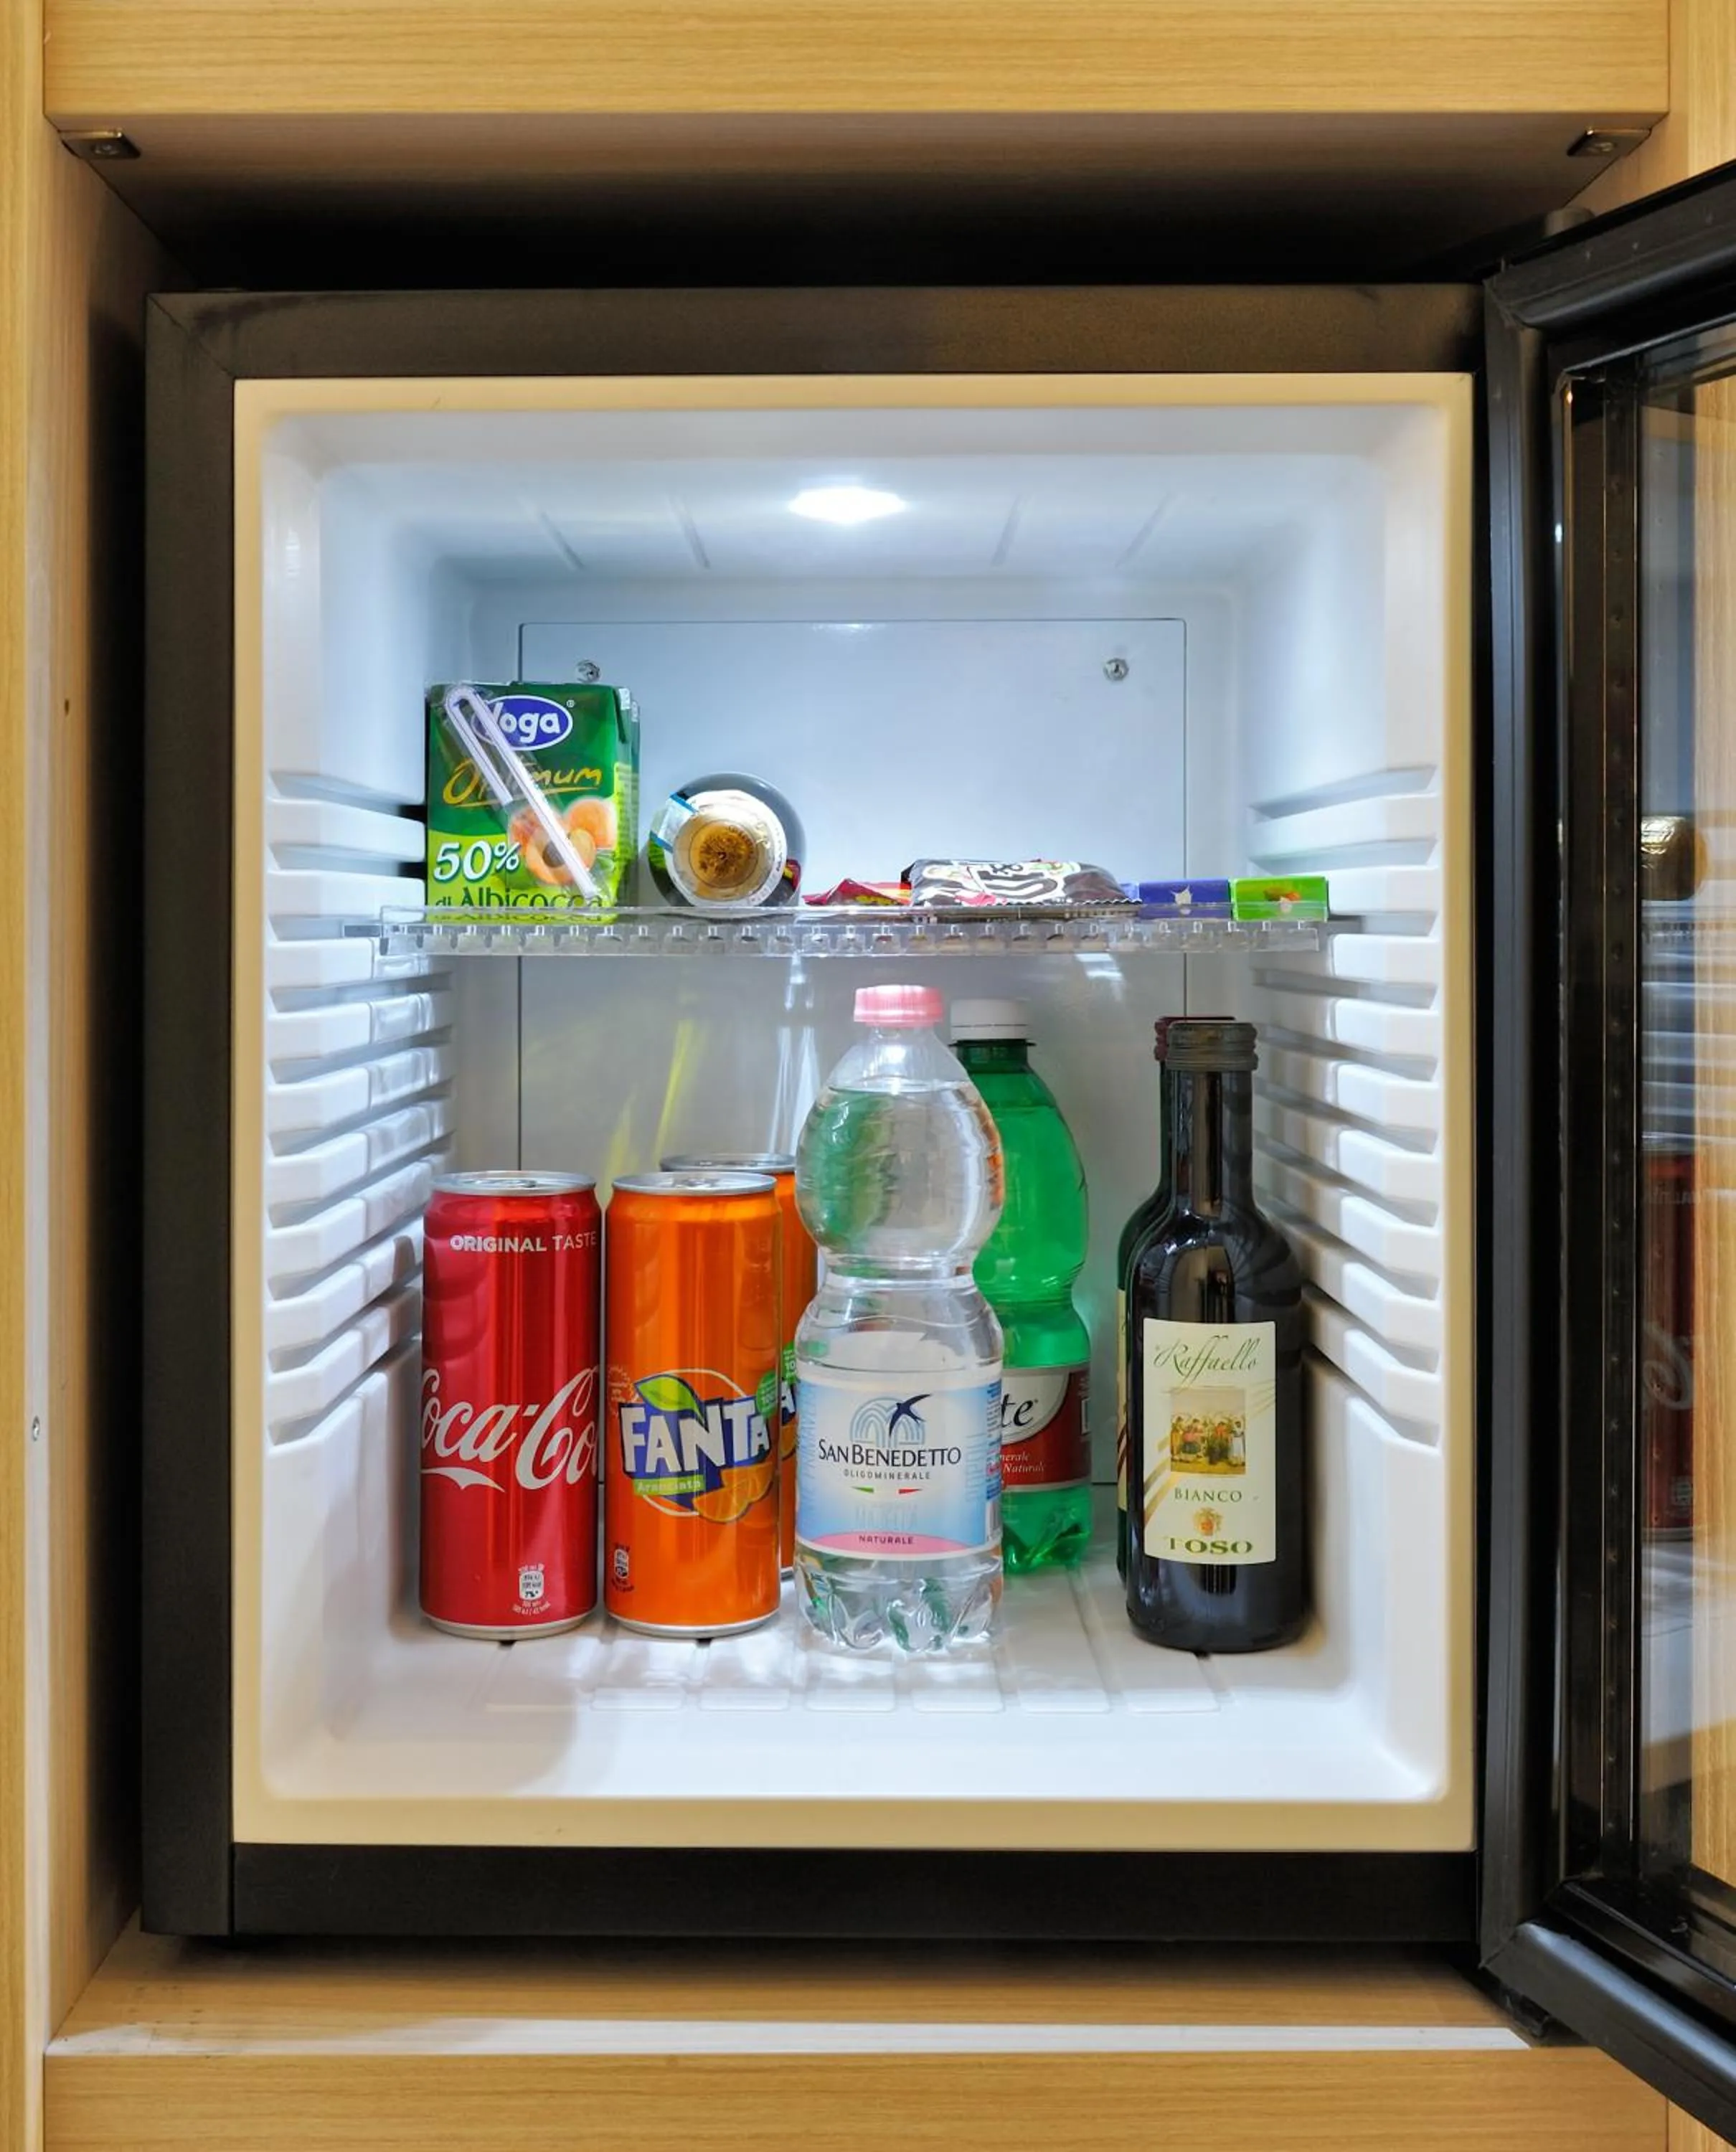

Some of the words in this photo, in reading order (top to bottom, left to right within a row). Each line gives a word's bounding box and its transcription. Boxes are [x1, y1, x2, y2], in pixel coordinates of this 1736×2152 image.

[443, 758, 603, 805] Omum
[433, 840, 522, 882] 50%
[450, 1234, 547, 1252] ORIGINAL
[552, 1230, 597, 1251] TASTE
[1153, 1335, 1260, 1384] Raffaello
[422, 1365, 599, 1490] oca-Co
[1001, 1393, 1034, 1428] te
[620, 1401, 770, 1473] FANTA
[844, 1468, 931, 1480] OLIGOMINERALE
[1174, 1488, 1242, 1503] BIANCO
[859, 1535, 914, 1544] NATURALE
